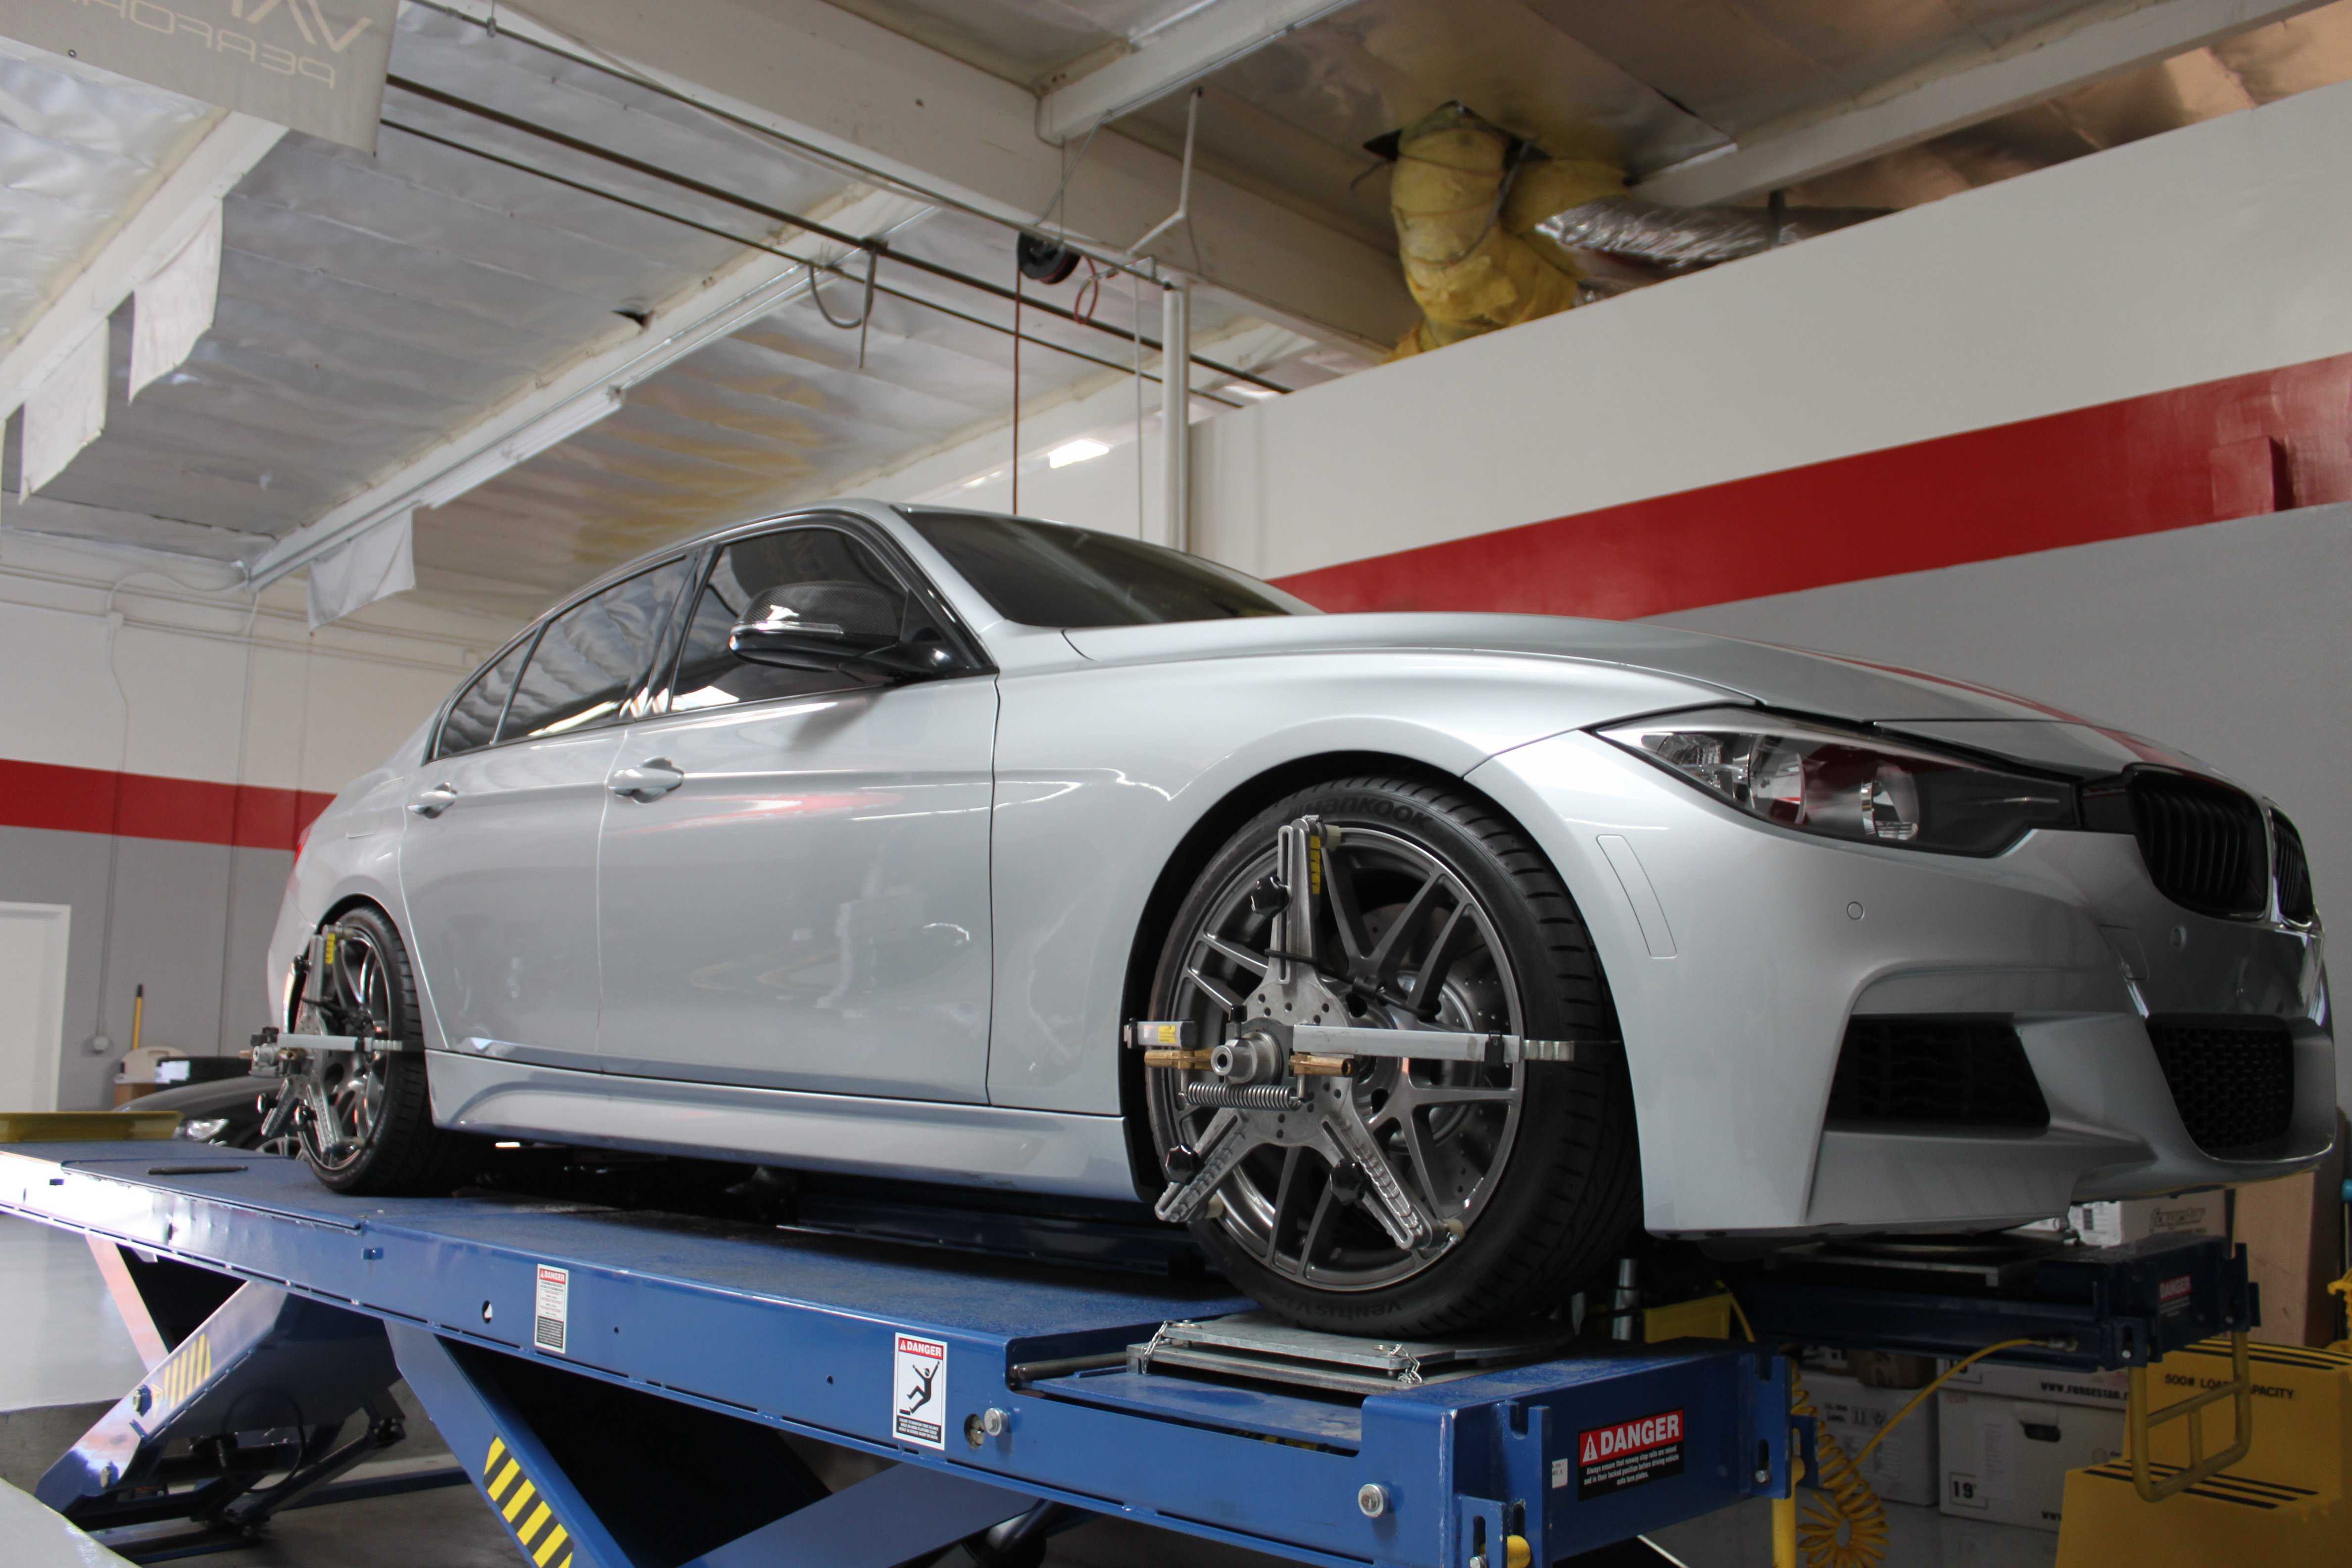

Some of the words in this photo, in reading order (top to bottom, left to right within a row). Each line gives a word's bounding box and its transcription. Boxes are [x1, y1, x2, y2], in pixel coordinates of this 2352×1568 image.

[907, 1340, 942, 1357] DANGER
[1600, 1414, 1679, 1456] DANGER
[1586, 1466, 1601, 1474] Always
[1608, 1468, 1621, 1478] locked
[1622, 1465, 1638, 1476] position
[1954, 1480, 1974, 1499] 19
